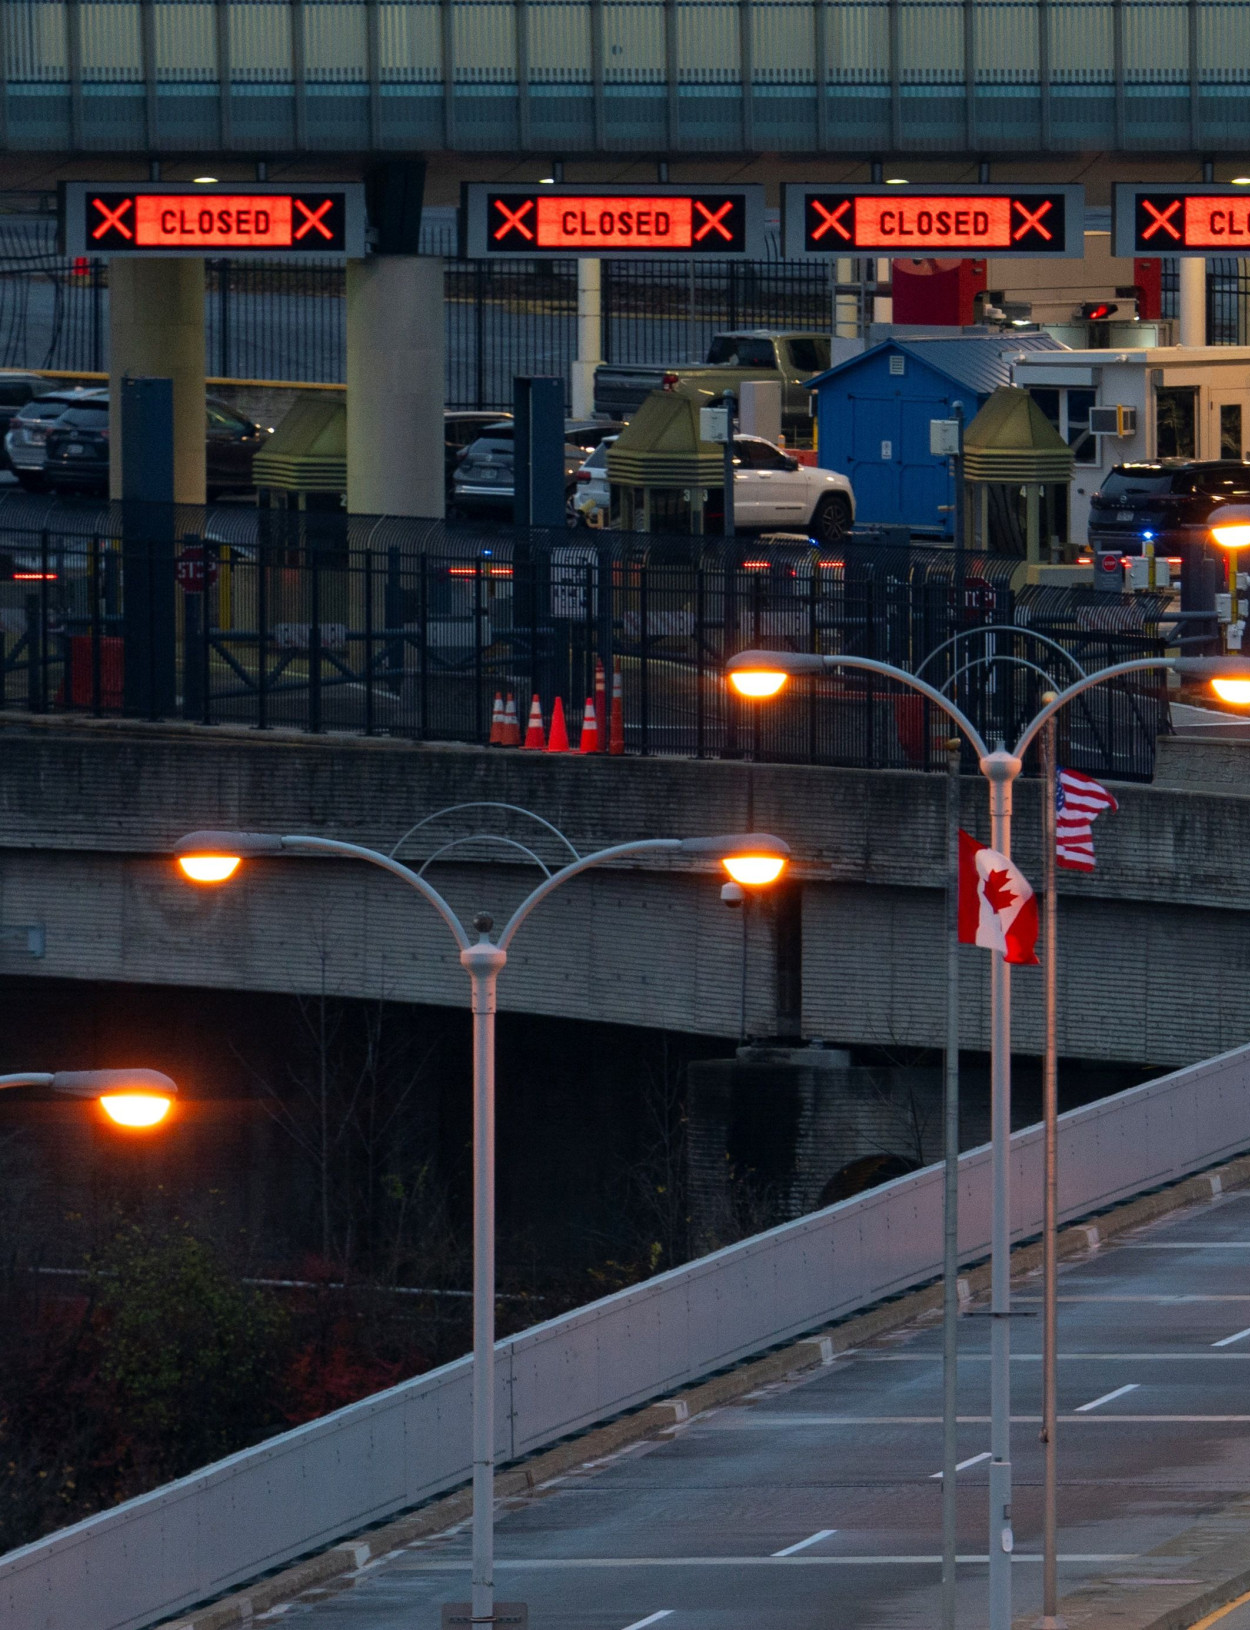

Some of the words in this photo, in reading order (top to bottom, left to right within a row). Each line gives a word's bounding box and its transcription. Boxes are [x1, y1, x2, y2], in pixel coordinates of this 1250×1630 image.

[161, 210, 270, 234] CLOSED
[561, 210, 670, 234] CLOSED
[879, 210, 989, 234] CLOSED
[340, 494, 347, 507] 2
[683, 489, 691, 502] 3
[702, 489, 709, 502] 3
